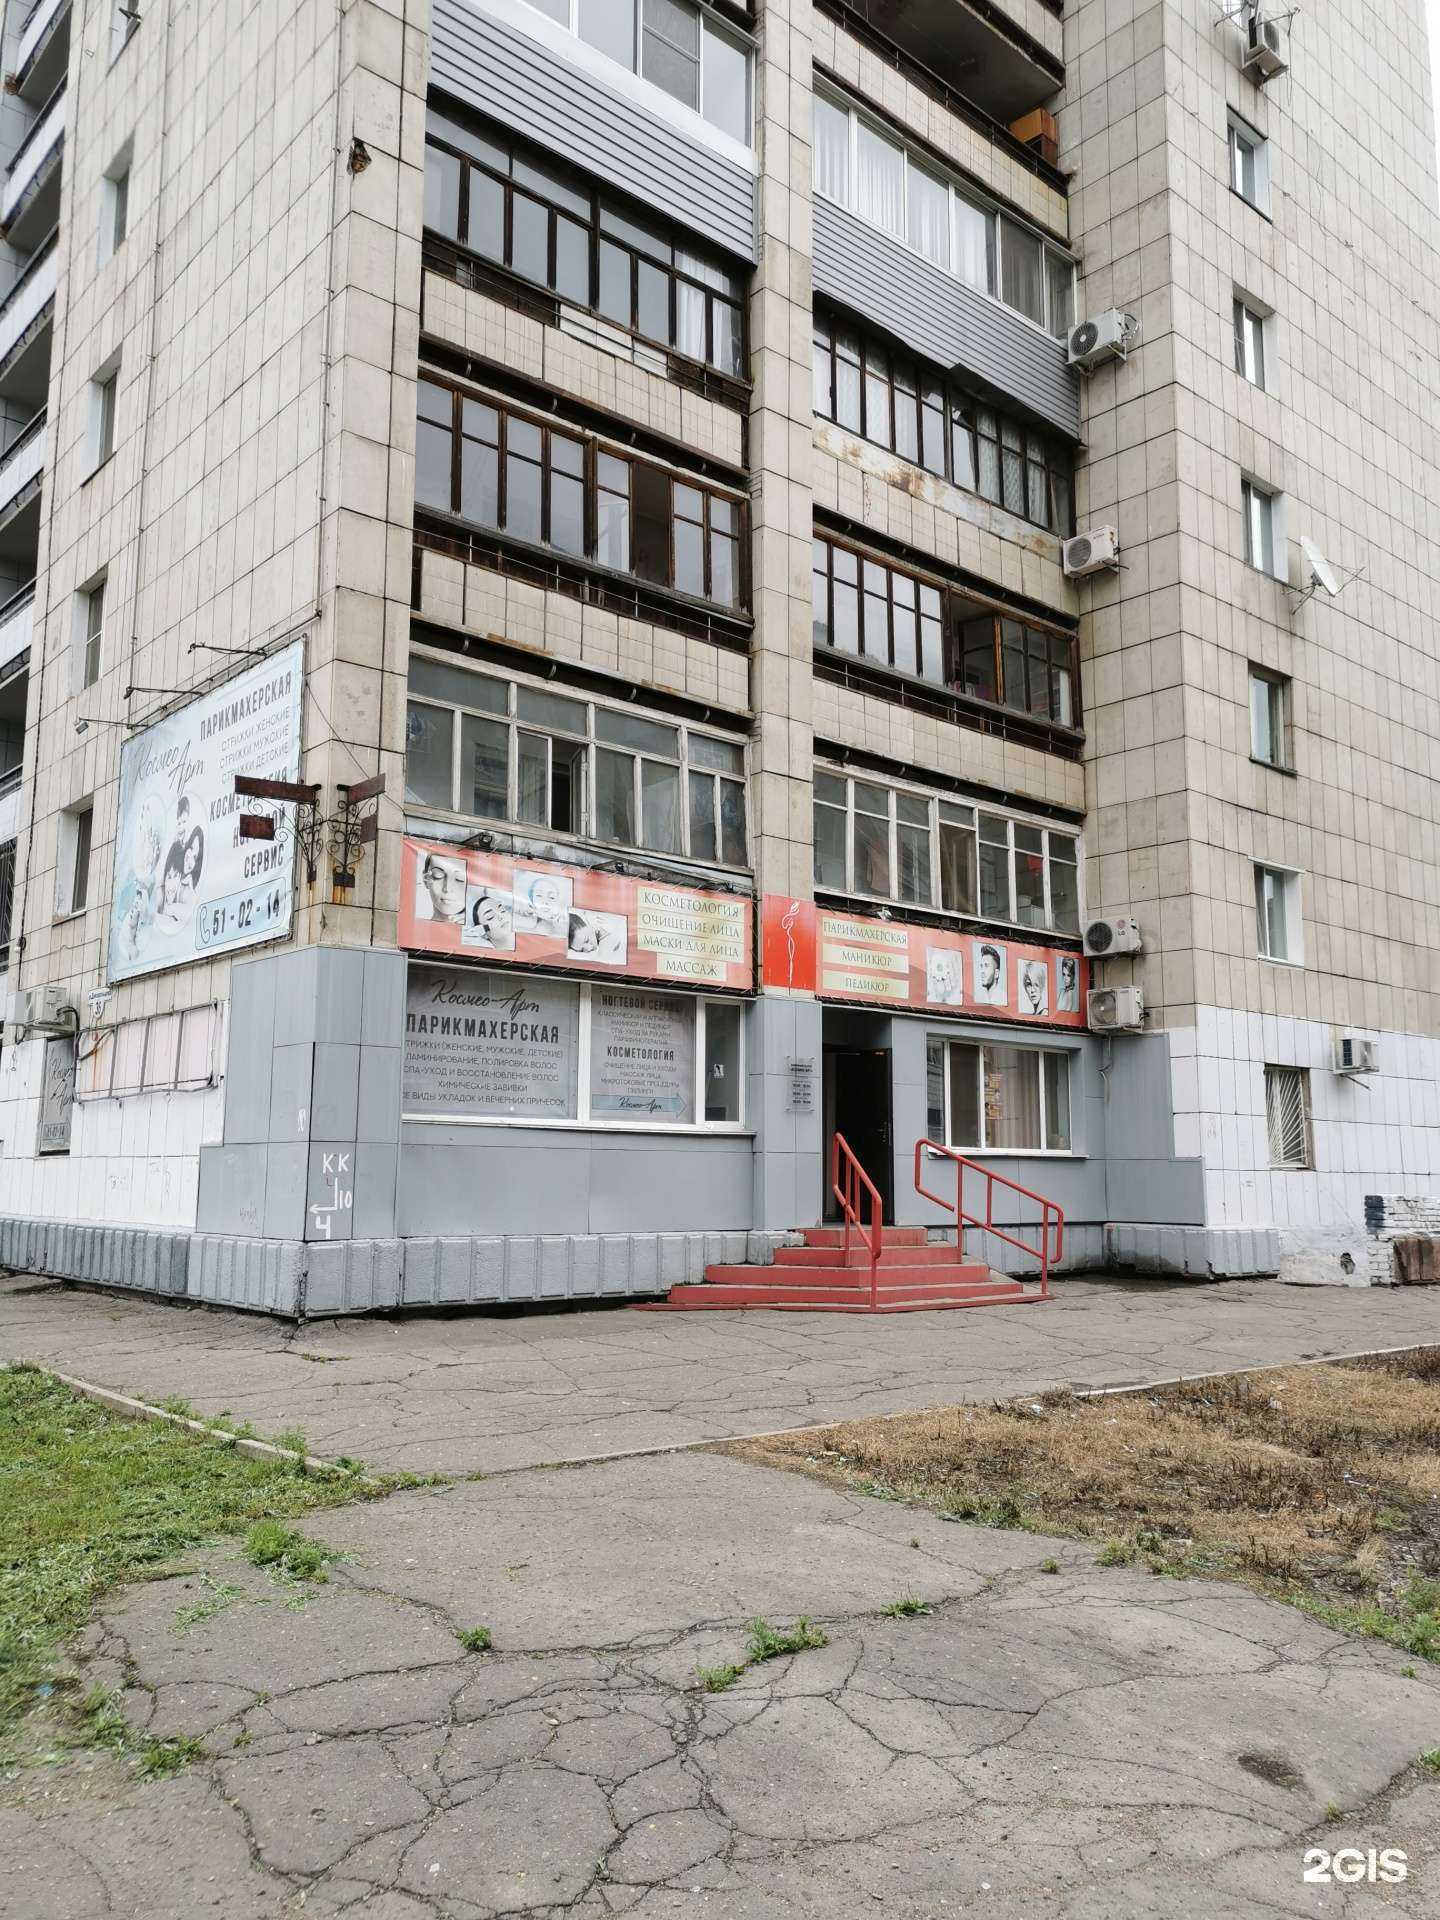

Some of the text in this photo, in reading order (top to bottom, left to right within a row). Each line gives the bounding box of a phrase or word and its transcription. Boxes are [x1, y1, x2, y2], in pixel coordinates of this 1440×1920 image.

[200, 670, 292, 741] ПАРИКМАХЕРСКАЯ
[244, 843, 284, 879] СЕРВИС
[644, 892, 739, 918] КОСМЕТОЛОГИЯ
[642, 914, 740, 938] ОЧИЩЕНИЕ ЛИЦА
[824, 922, 907, 944] ПАРИКМАХЕРСКАЯ
[643, 935, 739, 958] МАСКИ ДЛЯ ЛИЦА
[666, 960, 717, 976] МАССАЖ
[842, 951, 893, 966] МАНИКЮР
[845, 977, 889, 992] ПЕДИКЮР
[602, 994, 683, 1013] НОГТЕВОЙ СЕР
[406, 1014, 559, 1043] ПАРИКМАХЕРСКАЯ
[607, 1046, 674, 1061] КОСМЕТОЛОГИЯ
[531, 1062, 558, 1070] ВОЛОС
[532, 1073, 559, 1081] ВОЛОС
